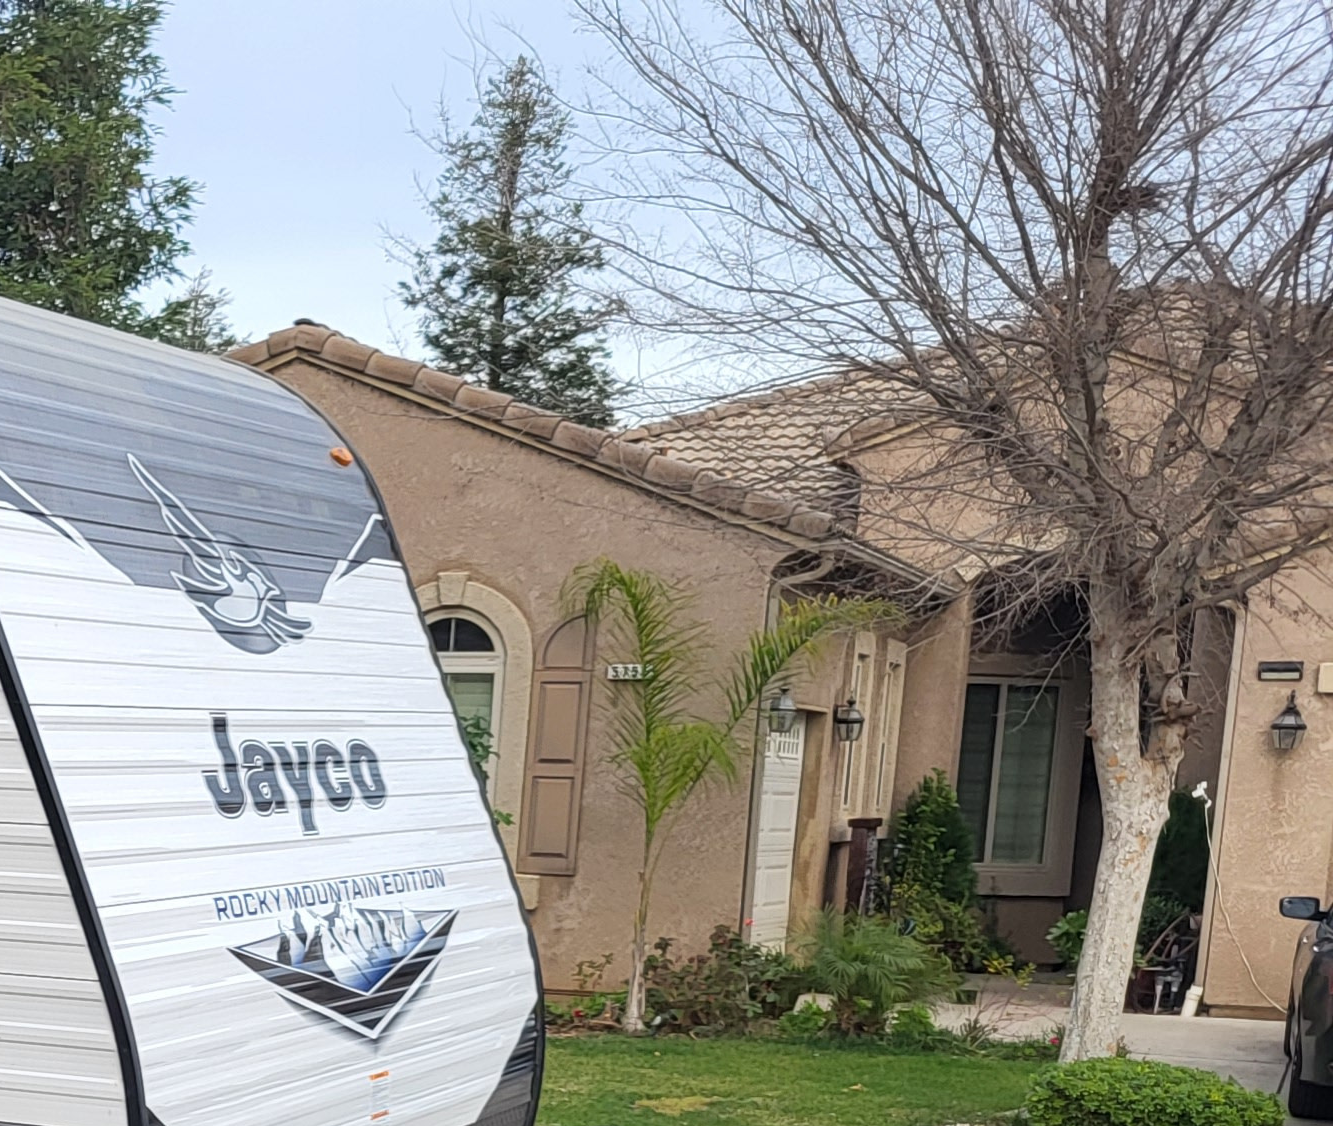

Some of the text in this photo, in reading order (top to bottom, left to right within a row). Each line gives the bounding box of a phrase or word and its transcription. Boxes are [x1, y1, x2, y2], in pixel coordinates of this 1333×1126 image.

[201, 712, 388, 836] Jayco
[213, 868, 446, 921] ROCKY MOUNTAIN EDITION
